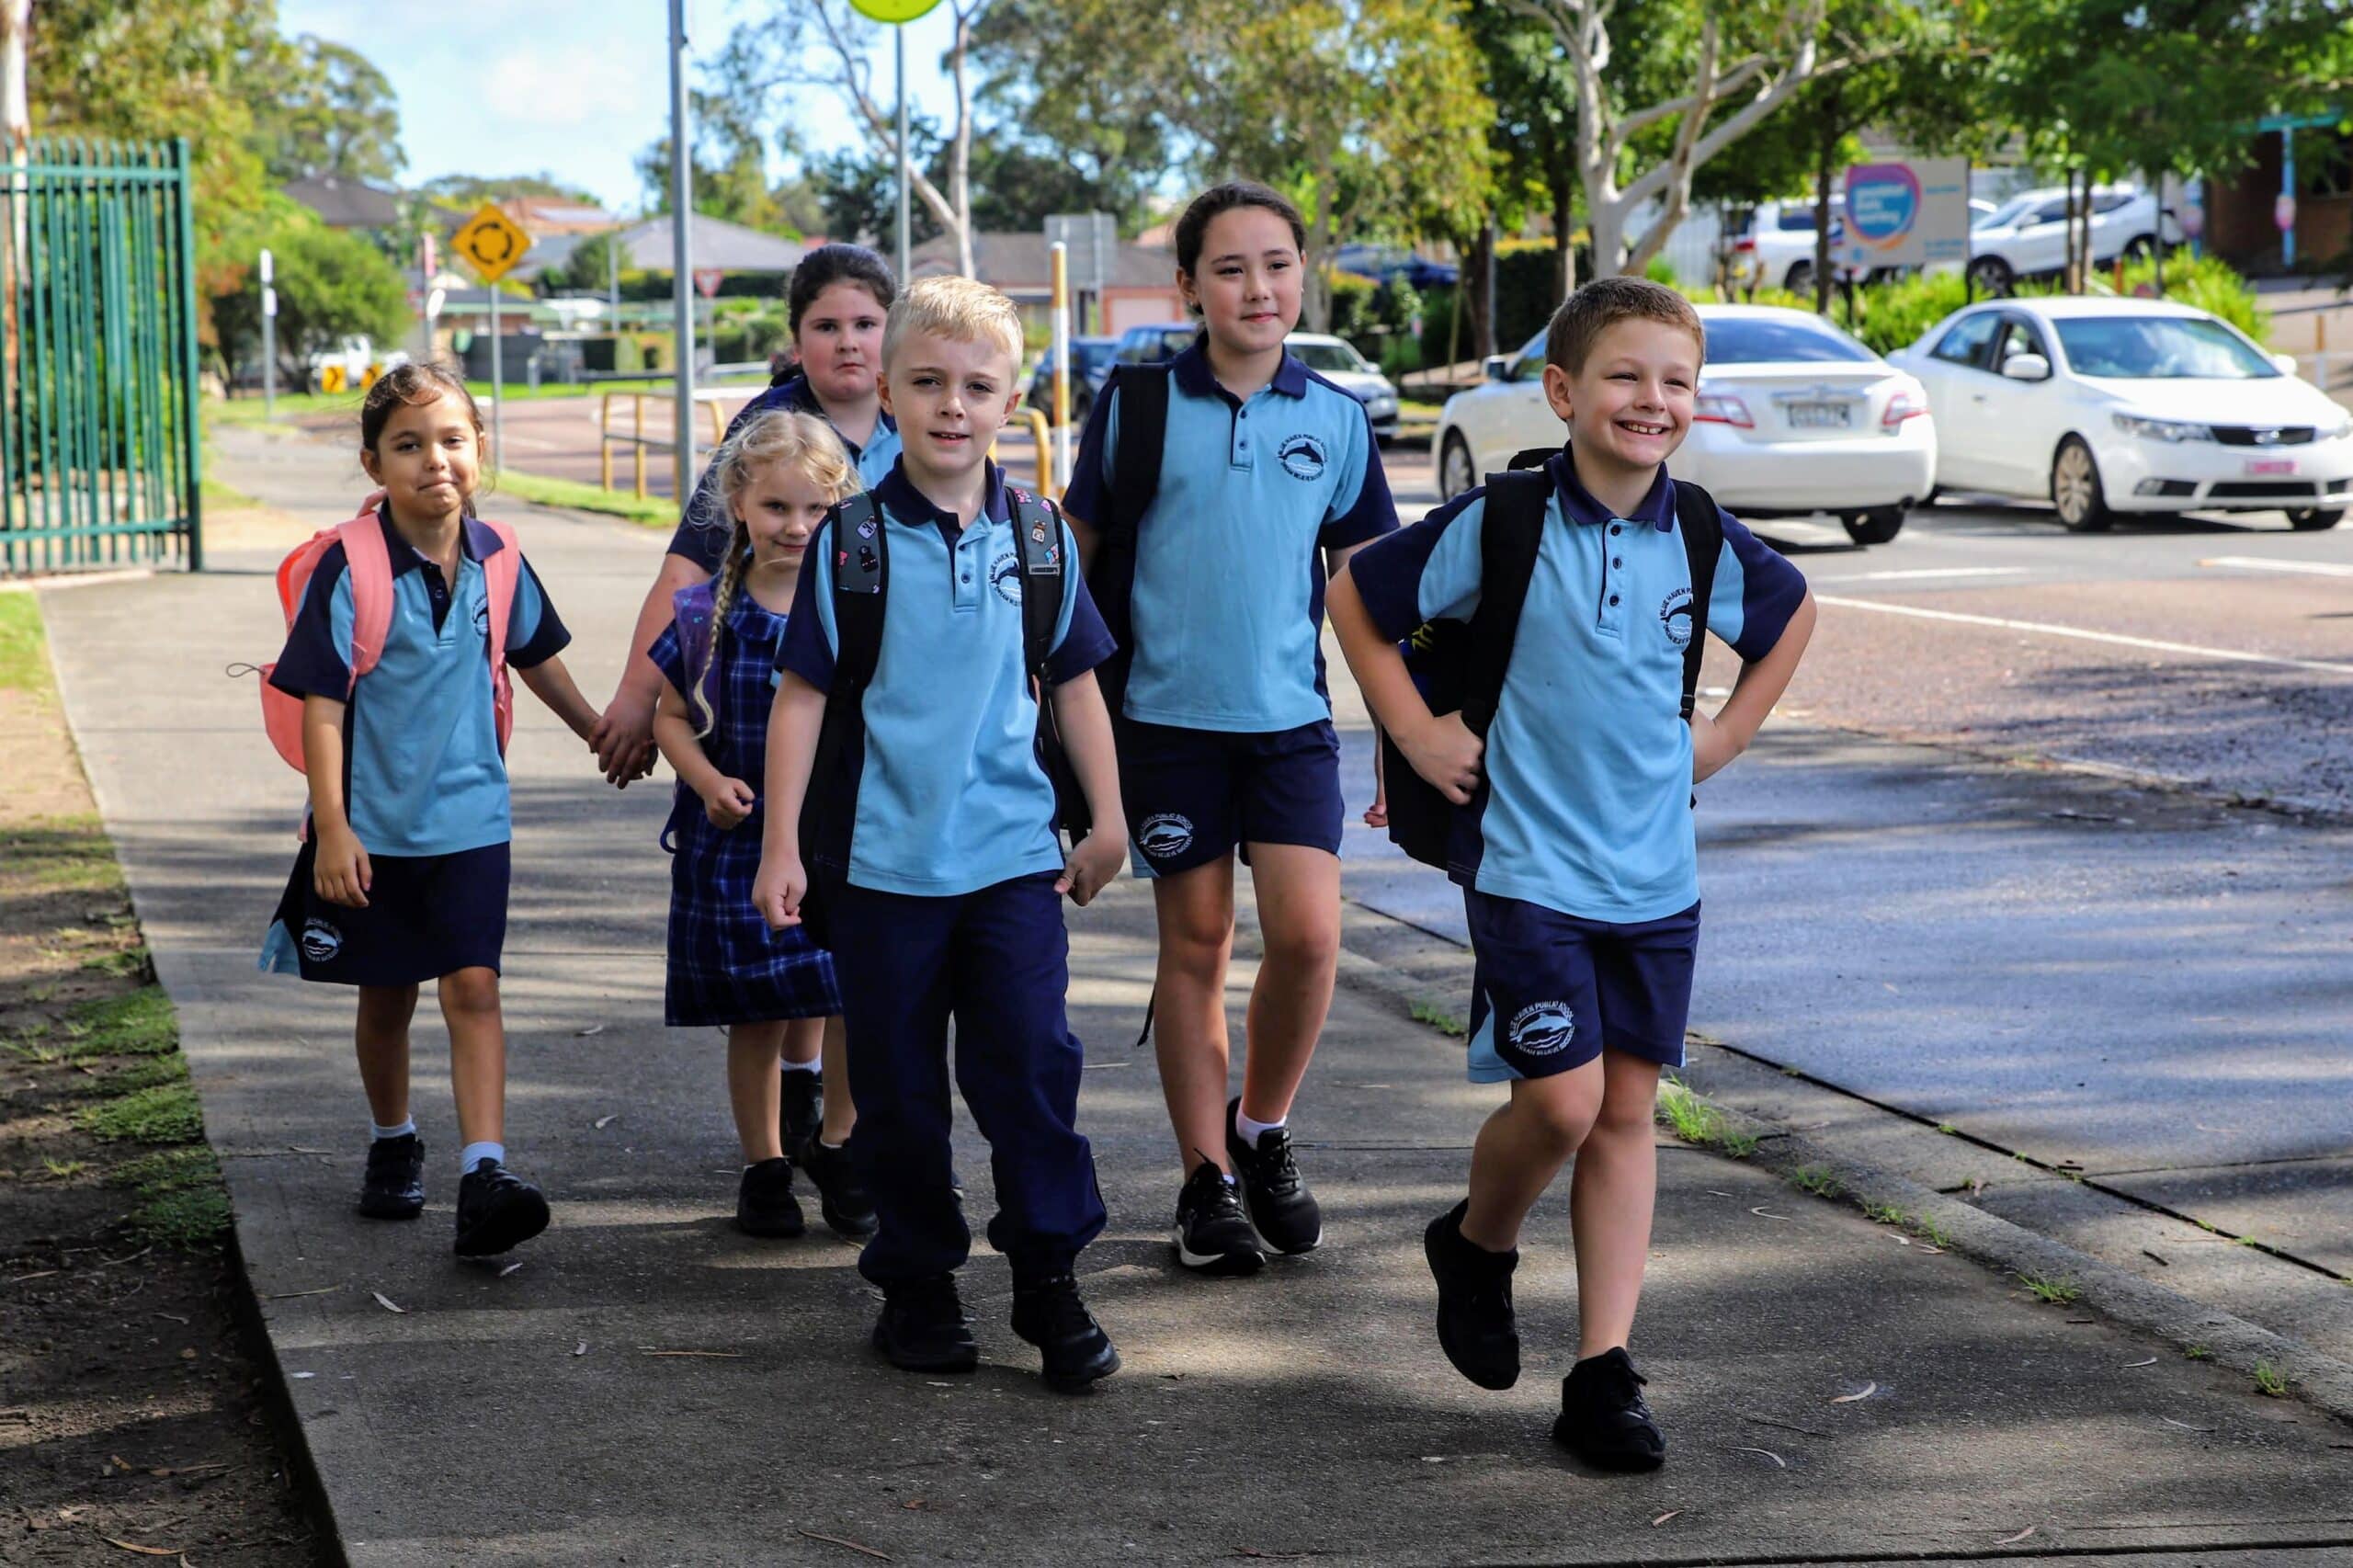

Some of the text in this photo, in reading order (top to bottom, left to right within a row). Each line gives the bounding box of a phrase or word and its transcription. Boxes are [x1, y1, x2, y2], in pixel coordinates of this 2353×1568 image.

[1660, 588, 1686, 617] BLUE HAVEN
[1176, 813, 1193, 831] SCHOOL
